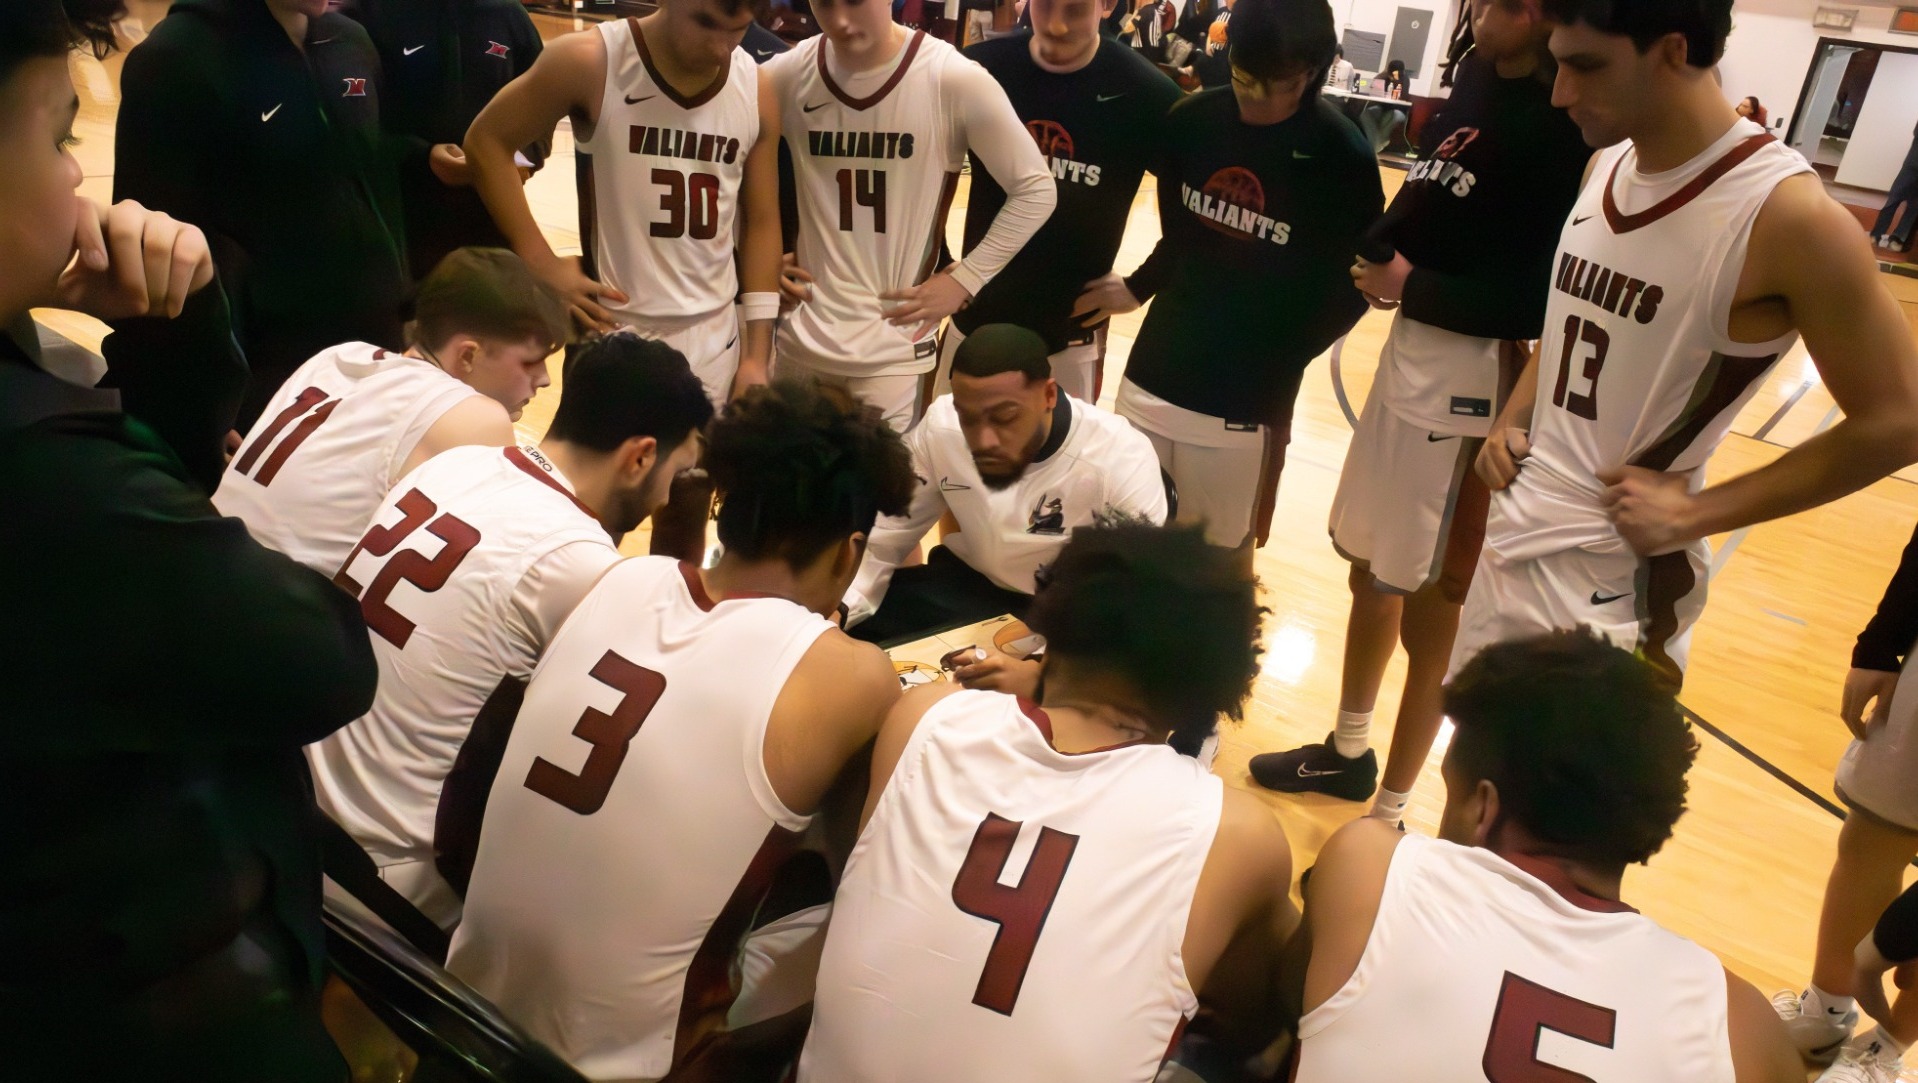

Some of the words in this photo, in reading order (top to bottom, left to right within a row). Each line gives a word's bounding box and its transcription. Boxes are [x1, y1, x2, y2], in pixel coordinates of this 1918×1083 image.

[629, 125, 740, 165] VALIANTS
[808, 130, 915, 159] VALIANTS
[650, 168, 719, 239] 30
[836, 168, 886, 234] 14
[1182, 182, 1291, 245] VALIANTS
[1555, 251, 1664, 324] VALIANTS
[1553, 314, 1610, 420] 13
[234, 386, 342, 487] 11
[333, 487, 481, 650] 22
[523, 648, 667, 816] 3
[952, 811, 1080, 1017] 4
